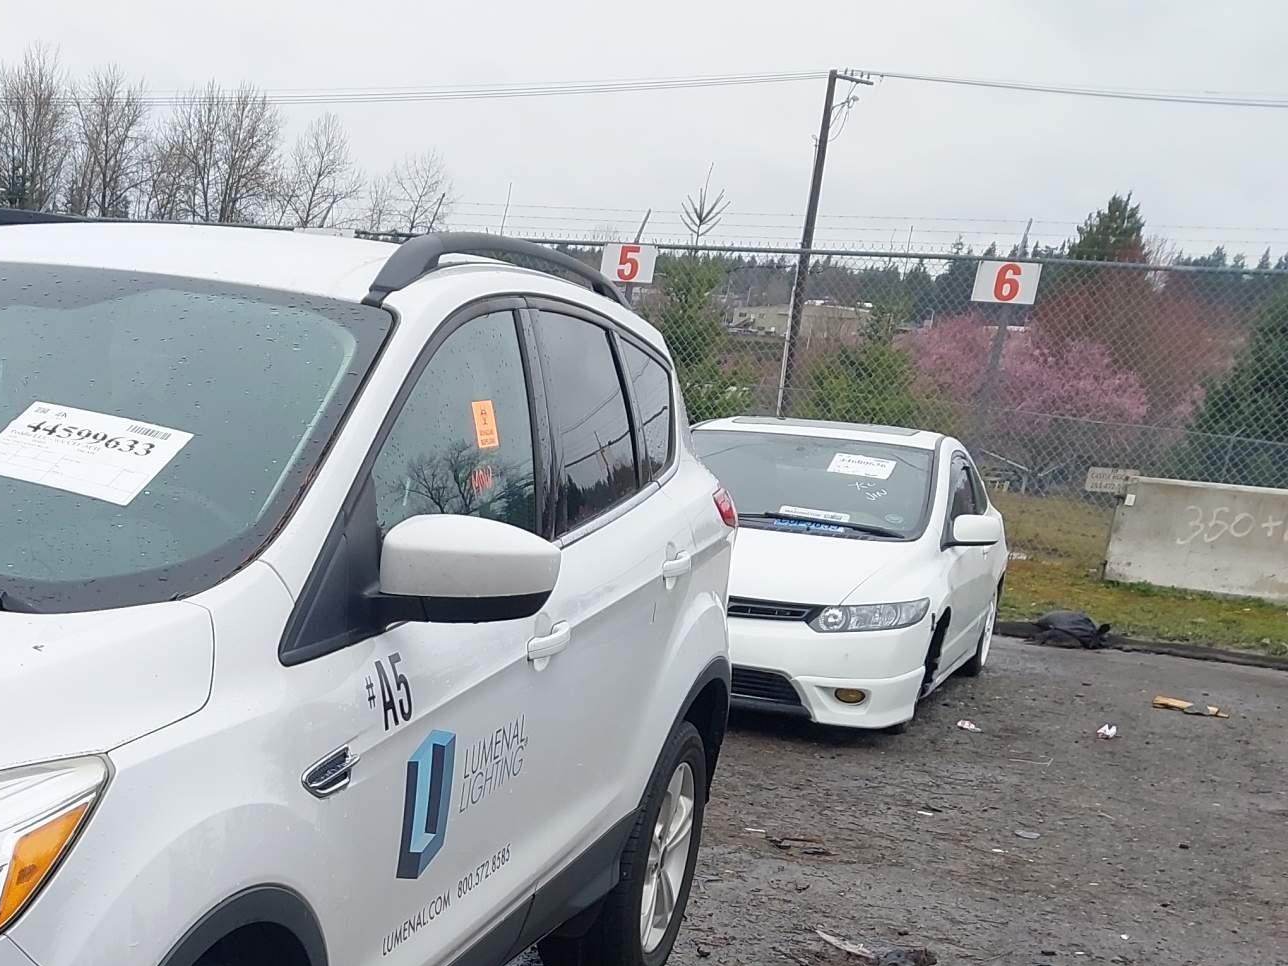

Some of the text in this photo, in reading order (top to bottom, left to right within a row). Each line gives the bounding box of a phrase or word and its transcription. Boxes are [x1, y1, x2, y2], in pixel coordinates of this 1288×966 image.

[616, 245, 641, 281] 5
[993, 263, 1022, 302] 6
[26, 420, 156, 457] 44599633
[463, 713, 526, 780] LUMENAL
[459, 745, 524, 814] LIGHTING
[382, 843, 512, 956] LUMENAL.COM 800.572.8585
